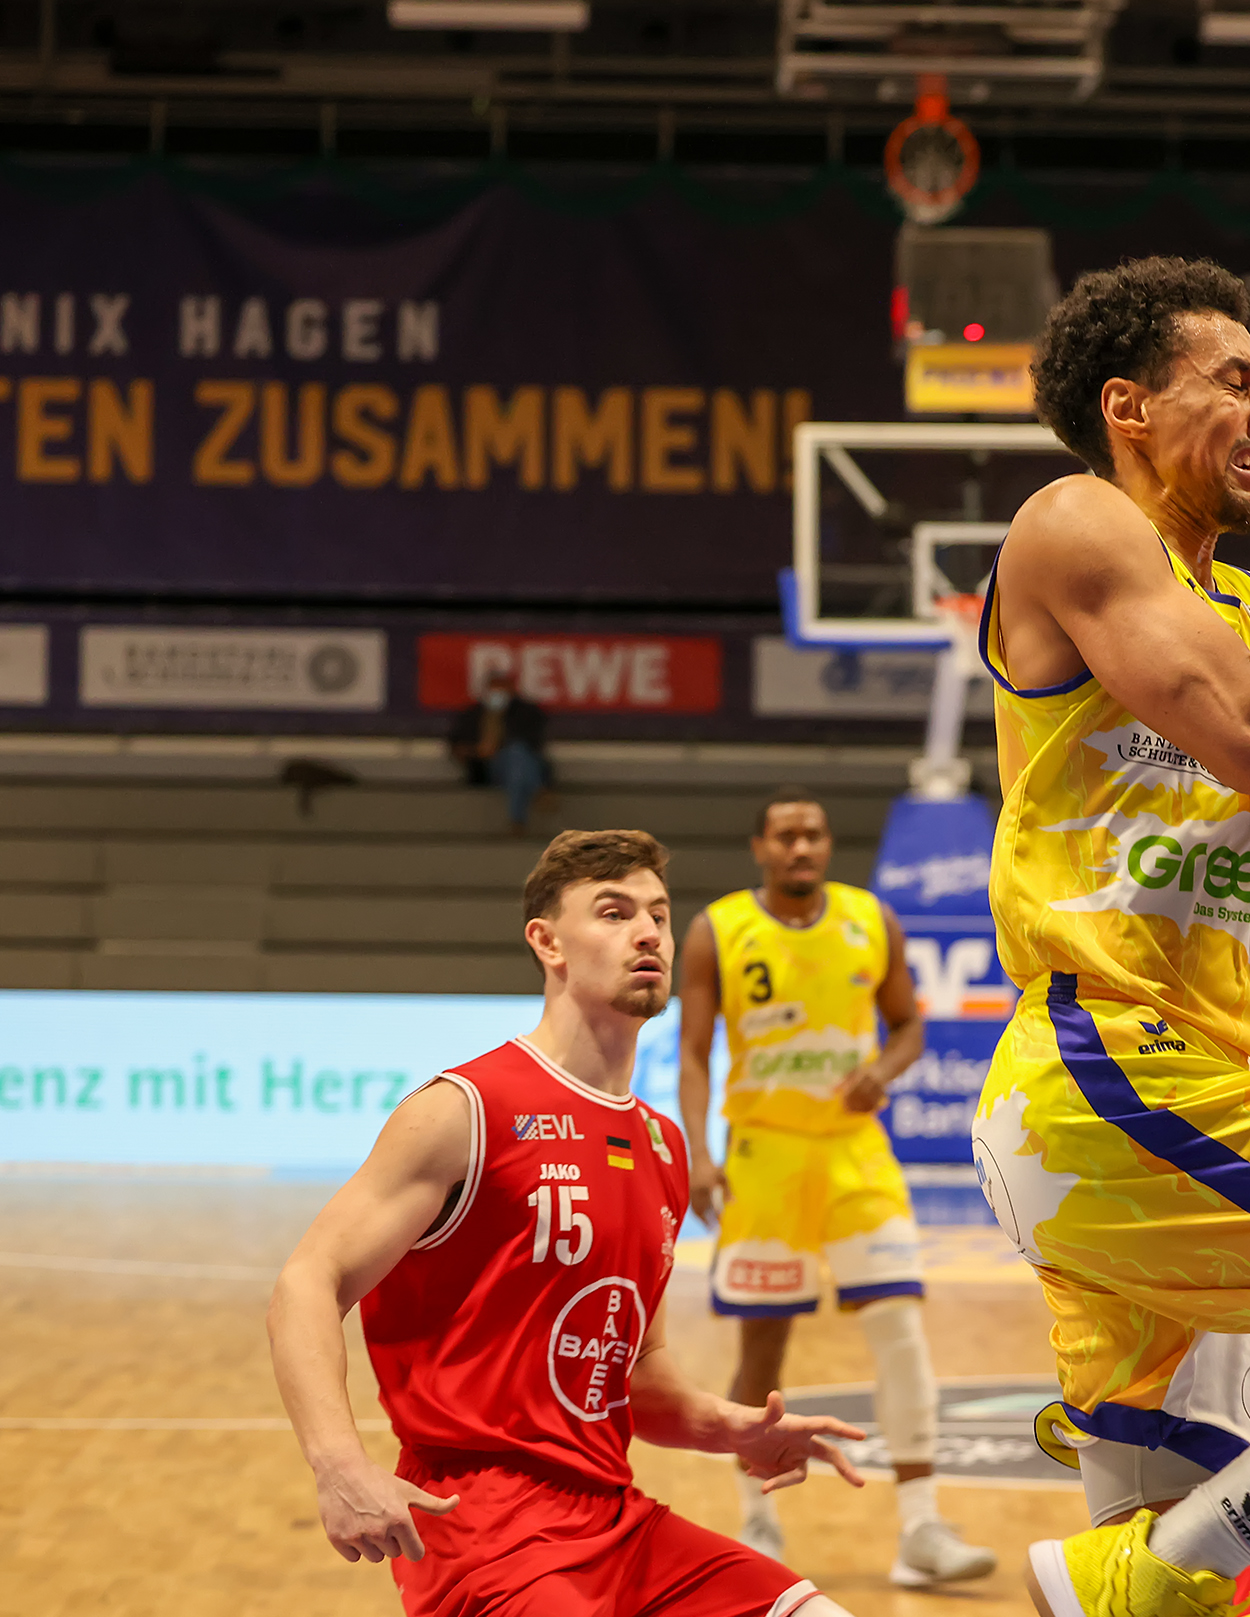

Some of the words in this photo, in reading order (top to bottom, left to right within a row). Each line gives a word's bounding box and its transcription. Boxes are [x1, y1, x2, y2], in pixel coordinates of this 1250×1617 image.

[178, 294, 441, 362] HAGEN
[0, 376, 155, 484] EN
[193, 378, 812, 493] ZUSAMMEN!
[744, 961, 773, 1003] 3
[1138, 1039, 1186, 1055] erima
[126, 1050, 230, 1111] mit
[262, 1057, 410, 1113] Herz
[536, 1114, 585, 1140] EVL
[539, 1163, 581, 1181] JAKO
[528, 1185, 594, 1266] 15
[558, 1333, 634, 1364] BAYE
[584, 1289, 622, 1411] BAYER
